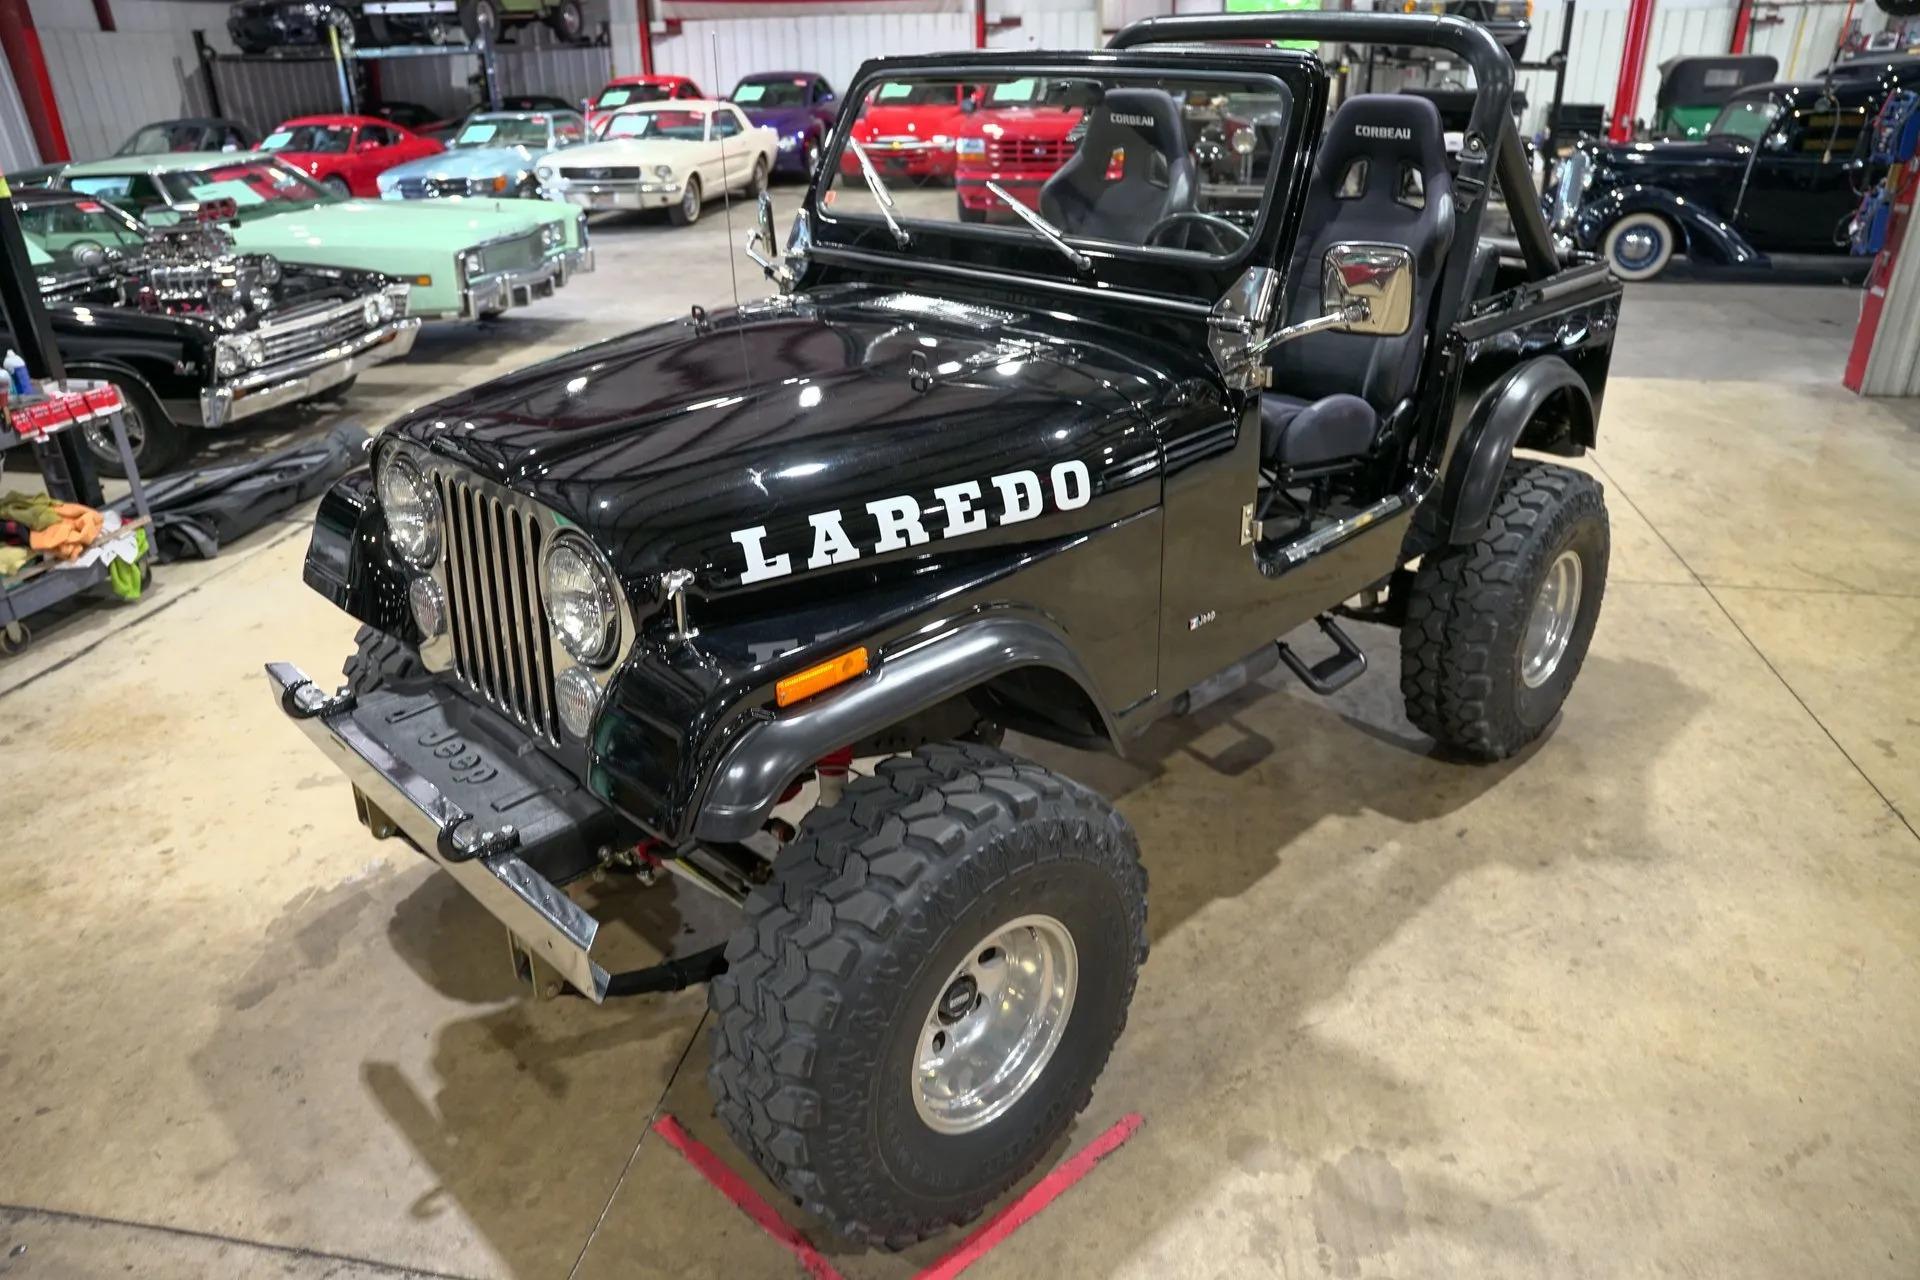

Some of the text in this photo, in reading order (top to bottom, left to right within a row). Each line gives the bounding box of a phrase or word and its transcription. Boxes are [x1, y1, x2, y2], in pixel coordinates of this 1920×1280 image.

[1355, 124, 1411, 140] CORBEAU
[730, 459, 1092, 586] LAREDO
[417, 729, 499, 785] Jeep
